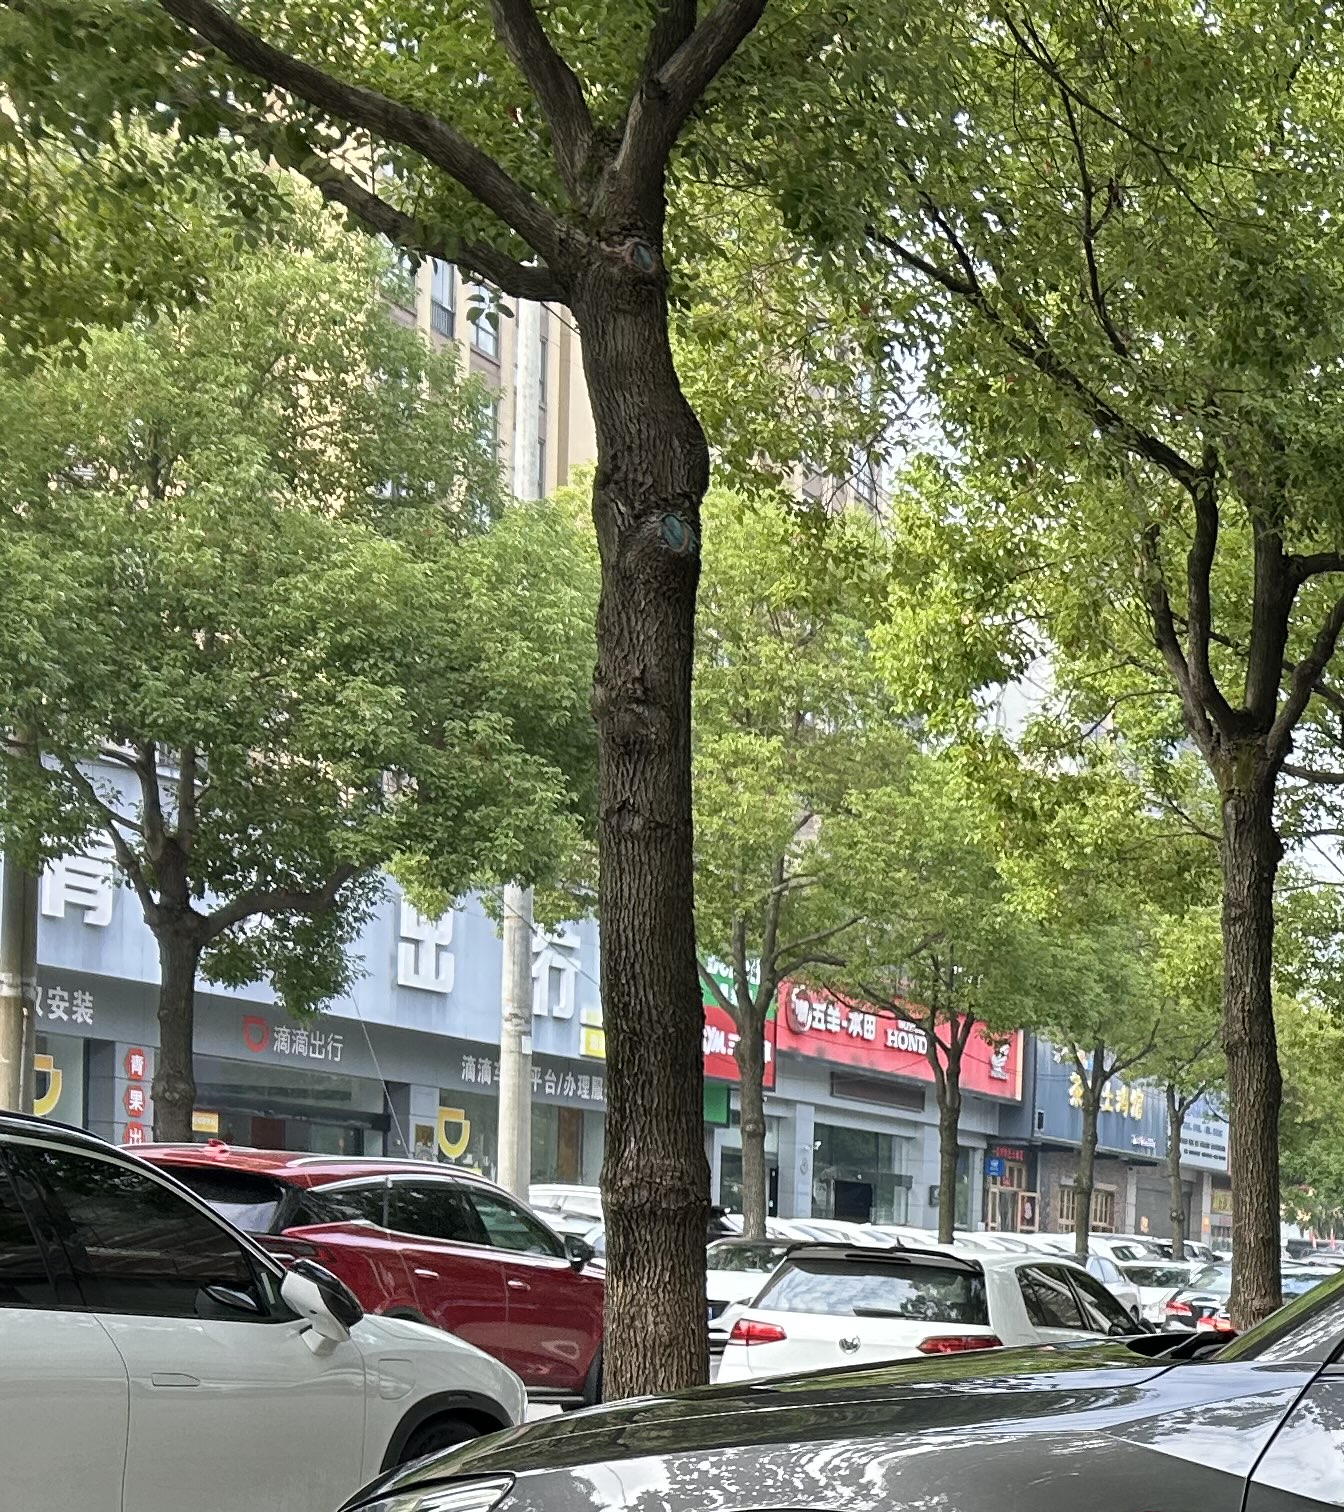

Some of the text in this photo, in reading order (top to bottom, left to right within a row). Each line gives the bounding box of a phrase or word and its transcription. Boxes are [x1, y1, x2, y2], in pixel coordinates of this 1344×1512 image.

[273, 1025, 344, 1062] 滴滴出行
[886, 1029, 928, 1055] HOND
